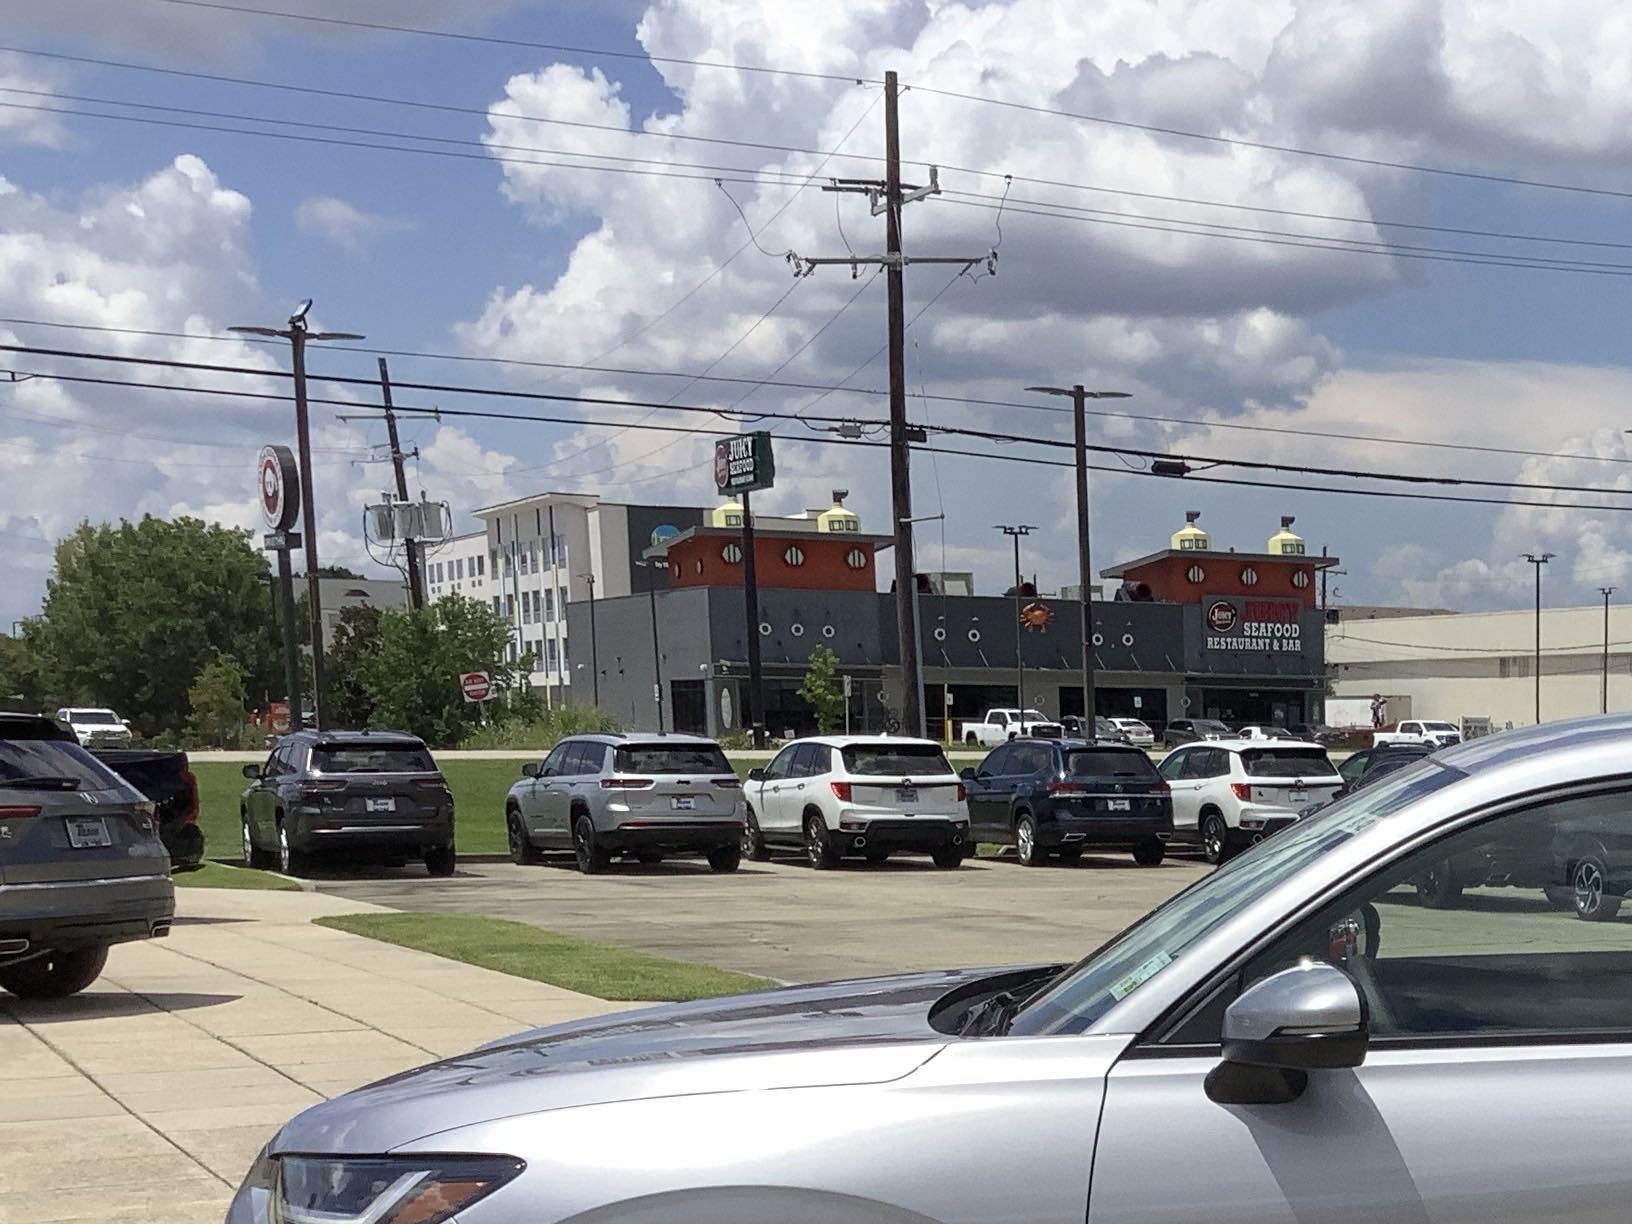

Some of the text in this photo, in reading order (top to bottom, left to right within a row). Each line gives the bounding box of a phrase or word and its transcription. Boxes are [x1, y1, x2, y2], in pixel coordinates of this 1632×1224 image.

[729, 436, 752, 461] JUICY
[1243, 622, 1300, 637] SEAFOOD
[1207, 637, 1270, 650] RESTAURANT
[1282, 639, 1301, 651] BAR
